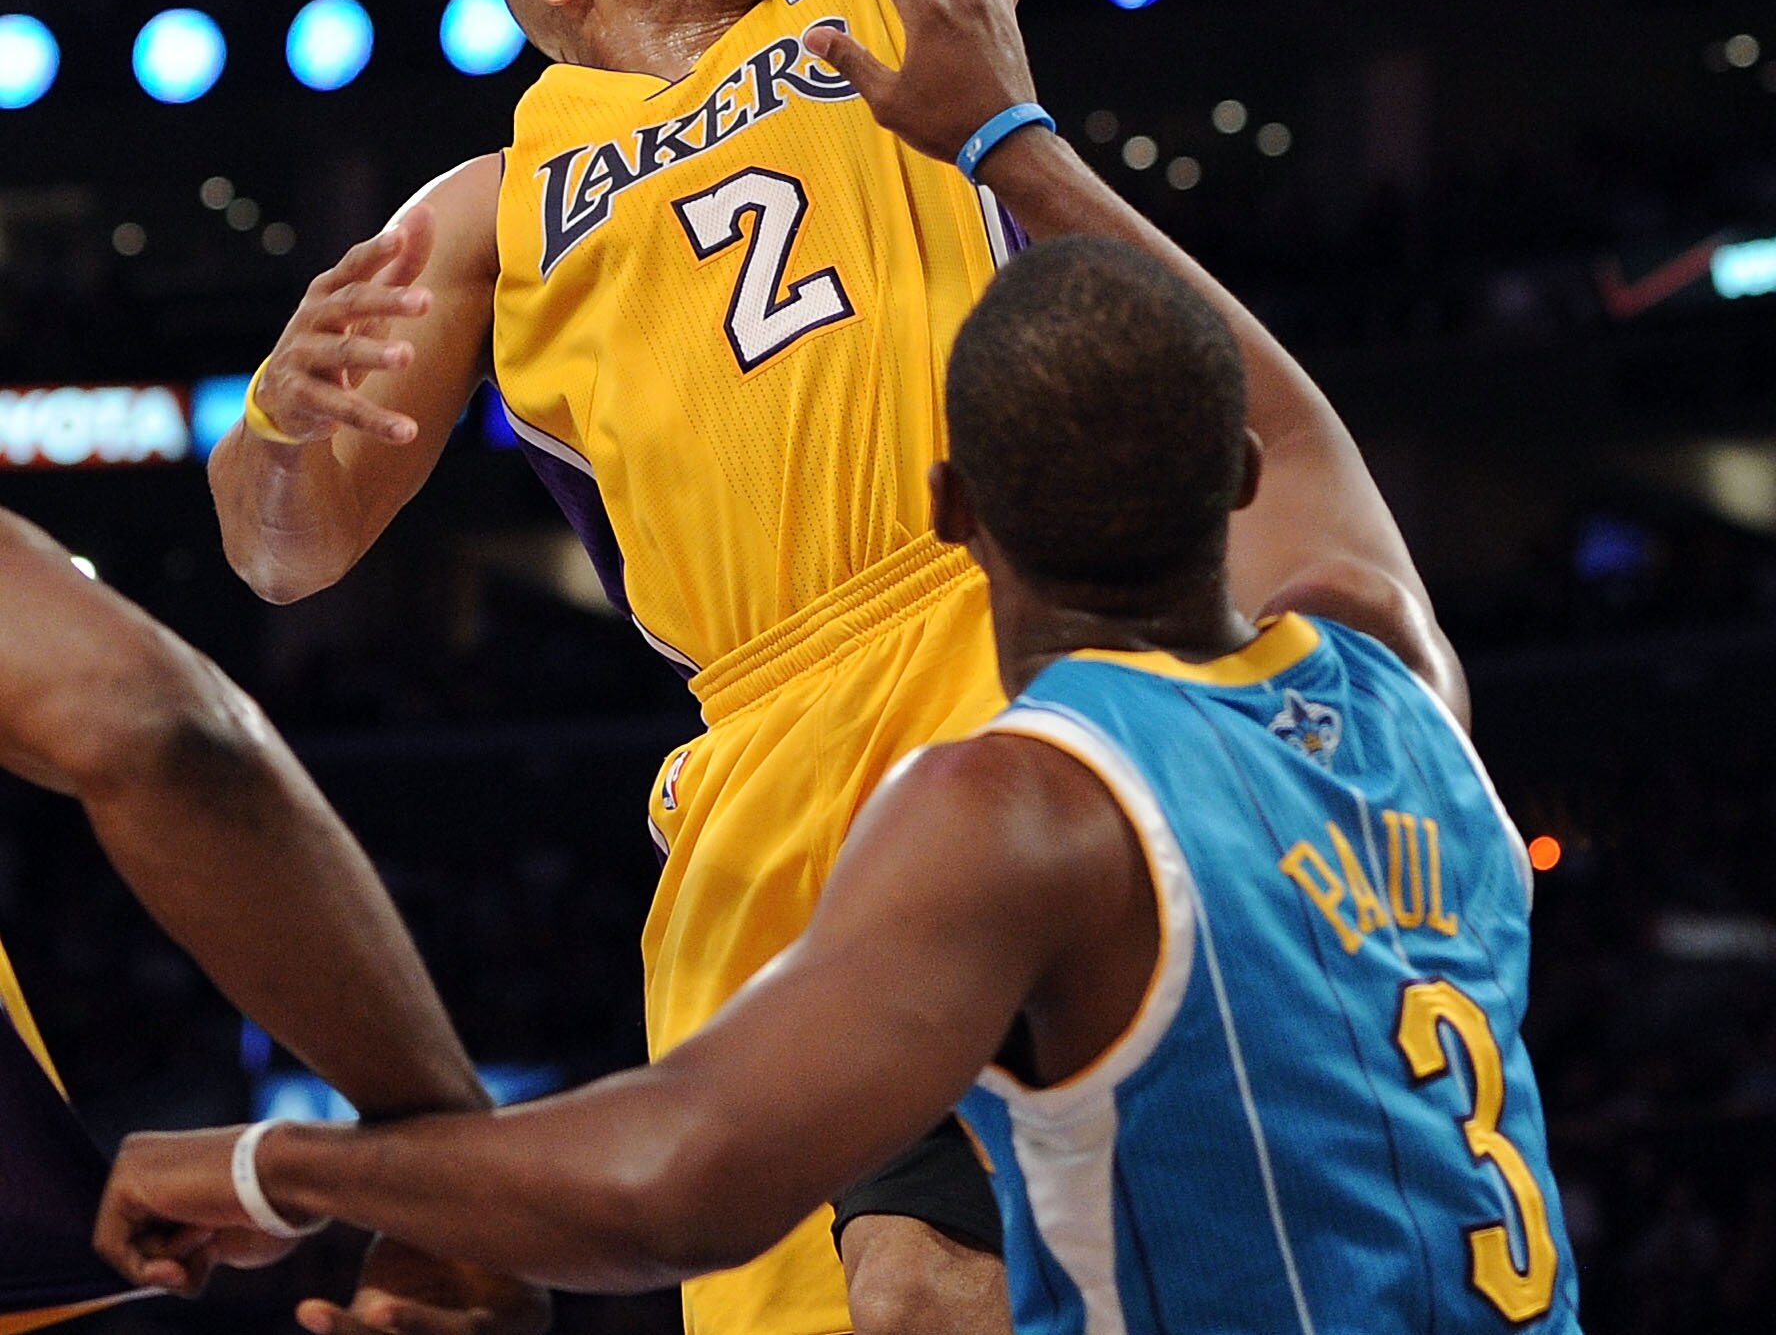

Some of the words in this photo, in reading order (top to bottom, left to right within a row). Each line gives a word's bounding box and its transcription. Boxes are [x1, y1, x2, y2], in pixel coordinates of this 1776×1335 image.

[669, 166, 857, 375] 2
[1279, 809, 1458, 955] PAUL
[1396, 979, 1557, 1322] 3
